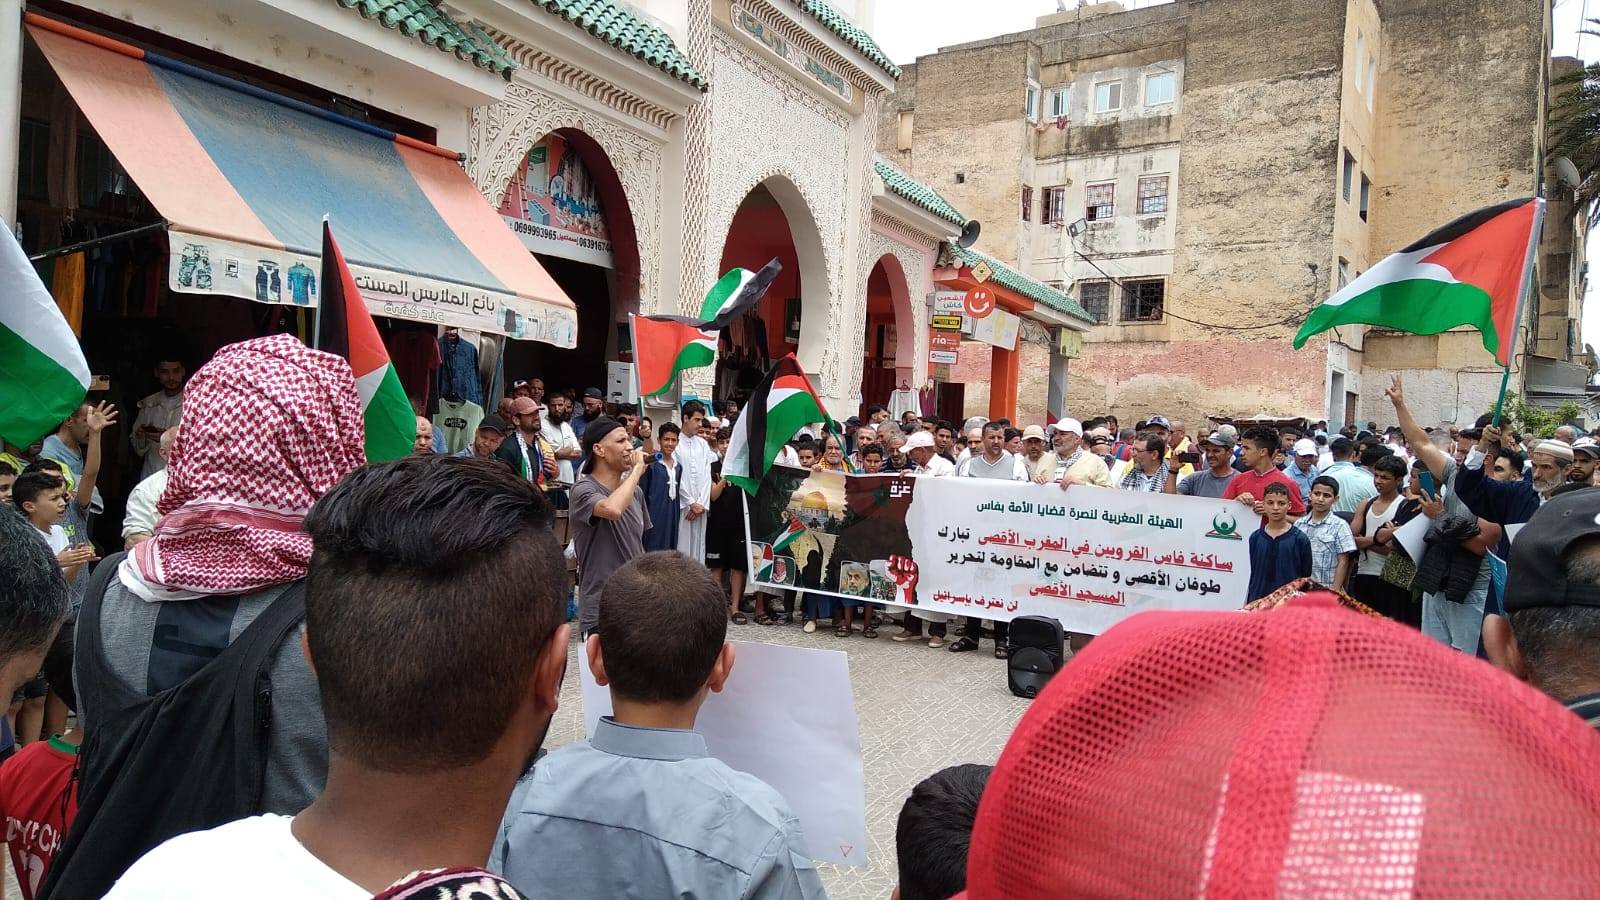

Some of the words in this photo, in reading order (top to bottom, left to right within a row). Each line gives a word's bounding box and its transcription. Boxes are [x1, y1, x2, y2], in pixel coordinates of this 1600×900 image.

[412, 287, 469, 306] الملابس
[472, 294, 495, 315] بائع
[932, 335, 947, 344] ria
[890, 480, 911, 498] غزة
[976, 499, 1005, 513] بفاس
[1008, 501, 1033, 514] الأمة
[1037, 503, 1066, 517] قضايا
[1069, 507, 1098, 520] لنصرة
[1101, 510, 1143, 525] المغربية
[1147, 514, 1183, 530] الهيئة
[937, 525, 970, 542] تبارك
[978, 529, 1020, 546] الأقصى
[1024, 534, 1068, 551] المغرب
[1071, 539, 1090, 558] في
[946, 551, 985, 564] لتحرير
[990, 552, 1040, 570] المقاومة
[1153, 550, 1185, 565] فاس
[1190, 551, 1233, 571] ساكنة
[1043, 561, 1059, 577] مع
[1063, 562, 1108, 578] تتضامن
[1112, 569, 1121, 583] و
[1125, 568, 1170, 587] الأقصى
[1029, 581, 1071, 597] الأقصى
[1175, 576, 1221, 596] طوفان
[974, 595, 1004, 609] نعترف
[1076, 588, 1125, 604] المسجد
[1006, 600, 1018, 612] لن
